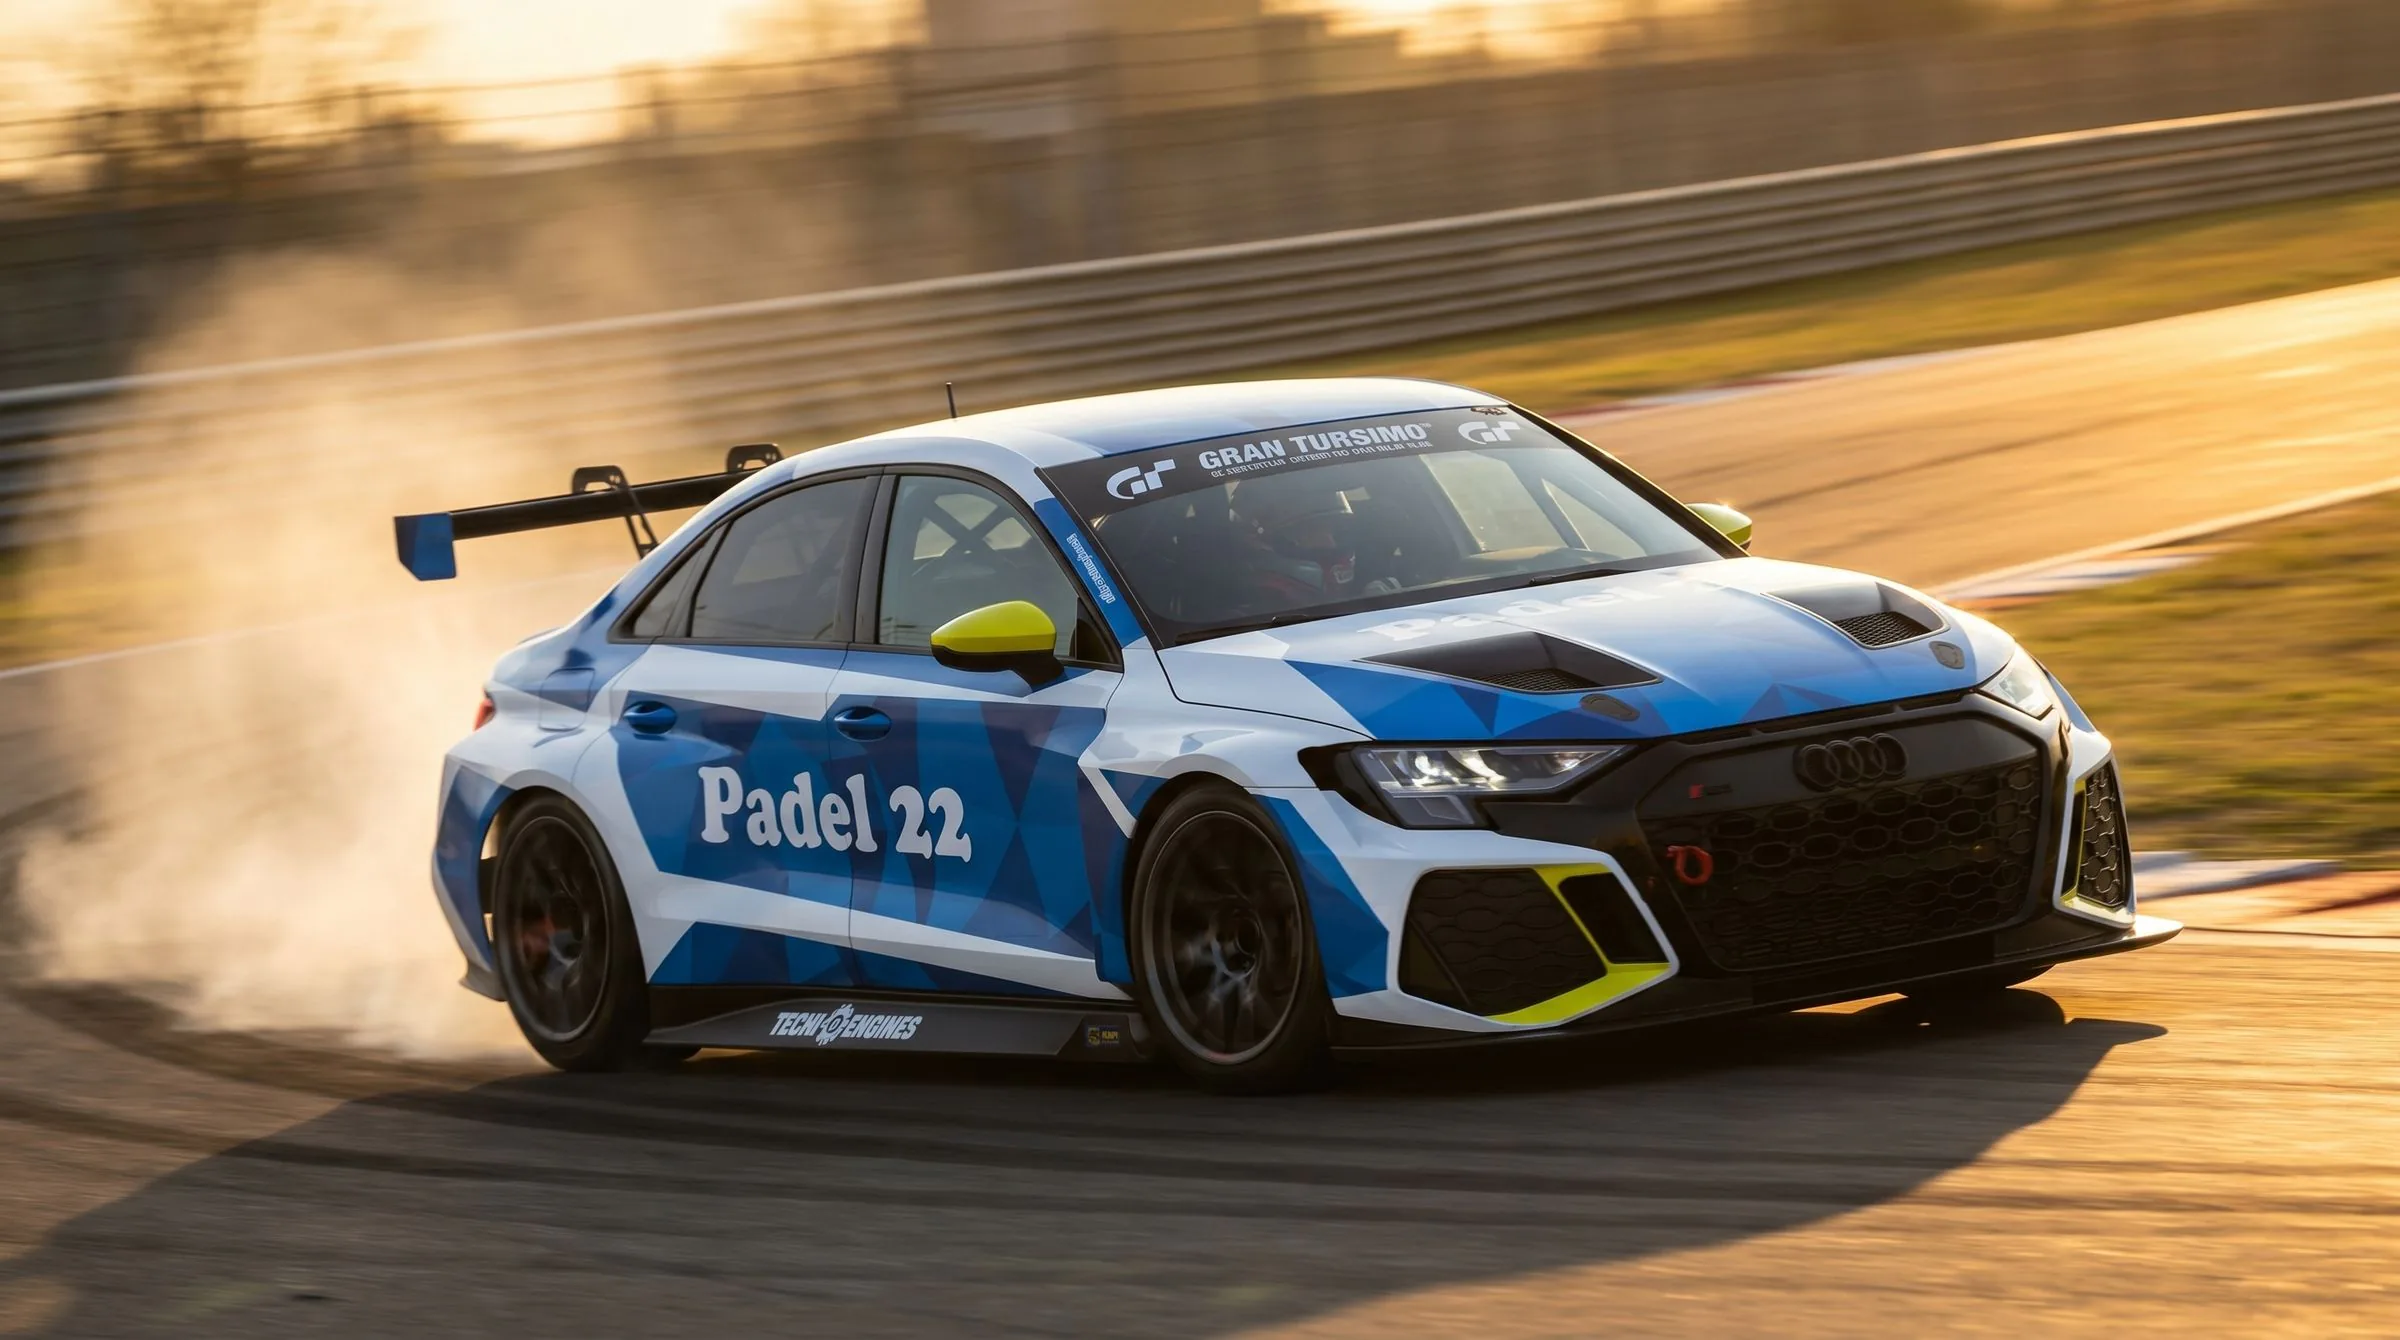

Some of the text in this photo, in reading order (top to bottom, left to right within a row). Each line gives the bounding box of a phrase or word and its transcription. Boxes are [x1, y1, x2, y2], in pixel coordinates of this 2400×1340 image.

[1199, 440, 1286, 470] GRAN
[1288, 424, 1427, 454] TURSIMO
[698, 766, 972, 863] Padel 22
[840, 1014, 924, 1041] ENGINES
